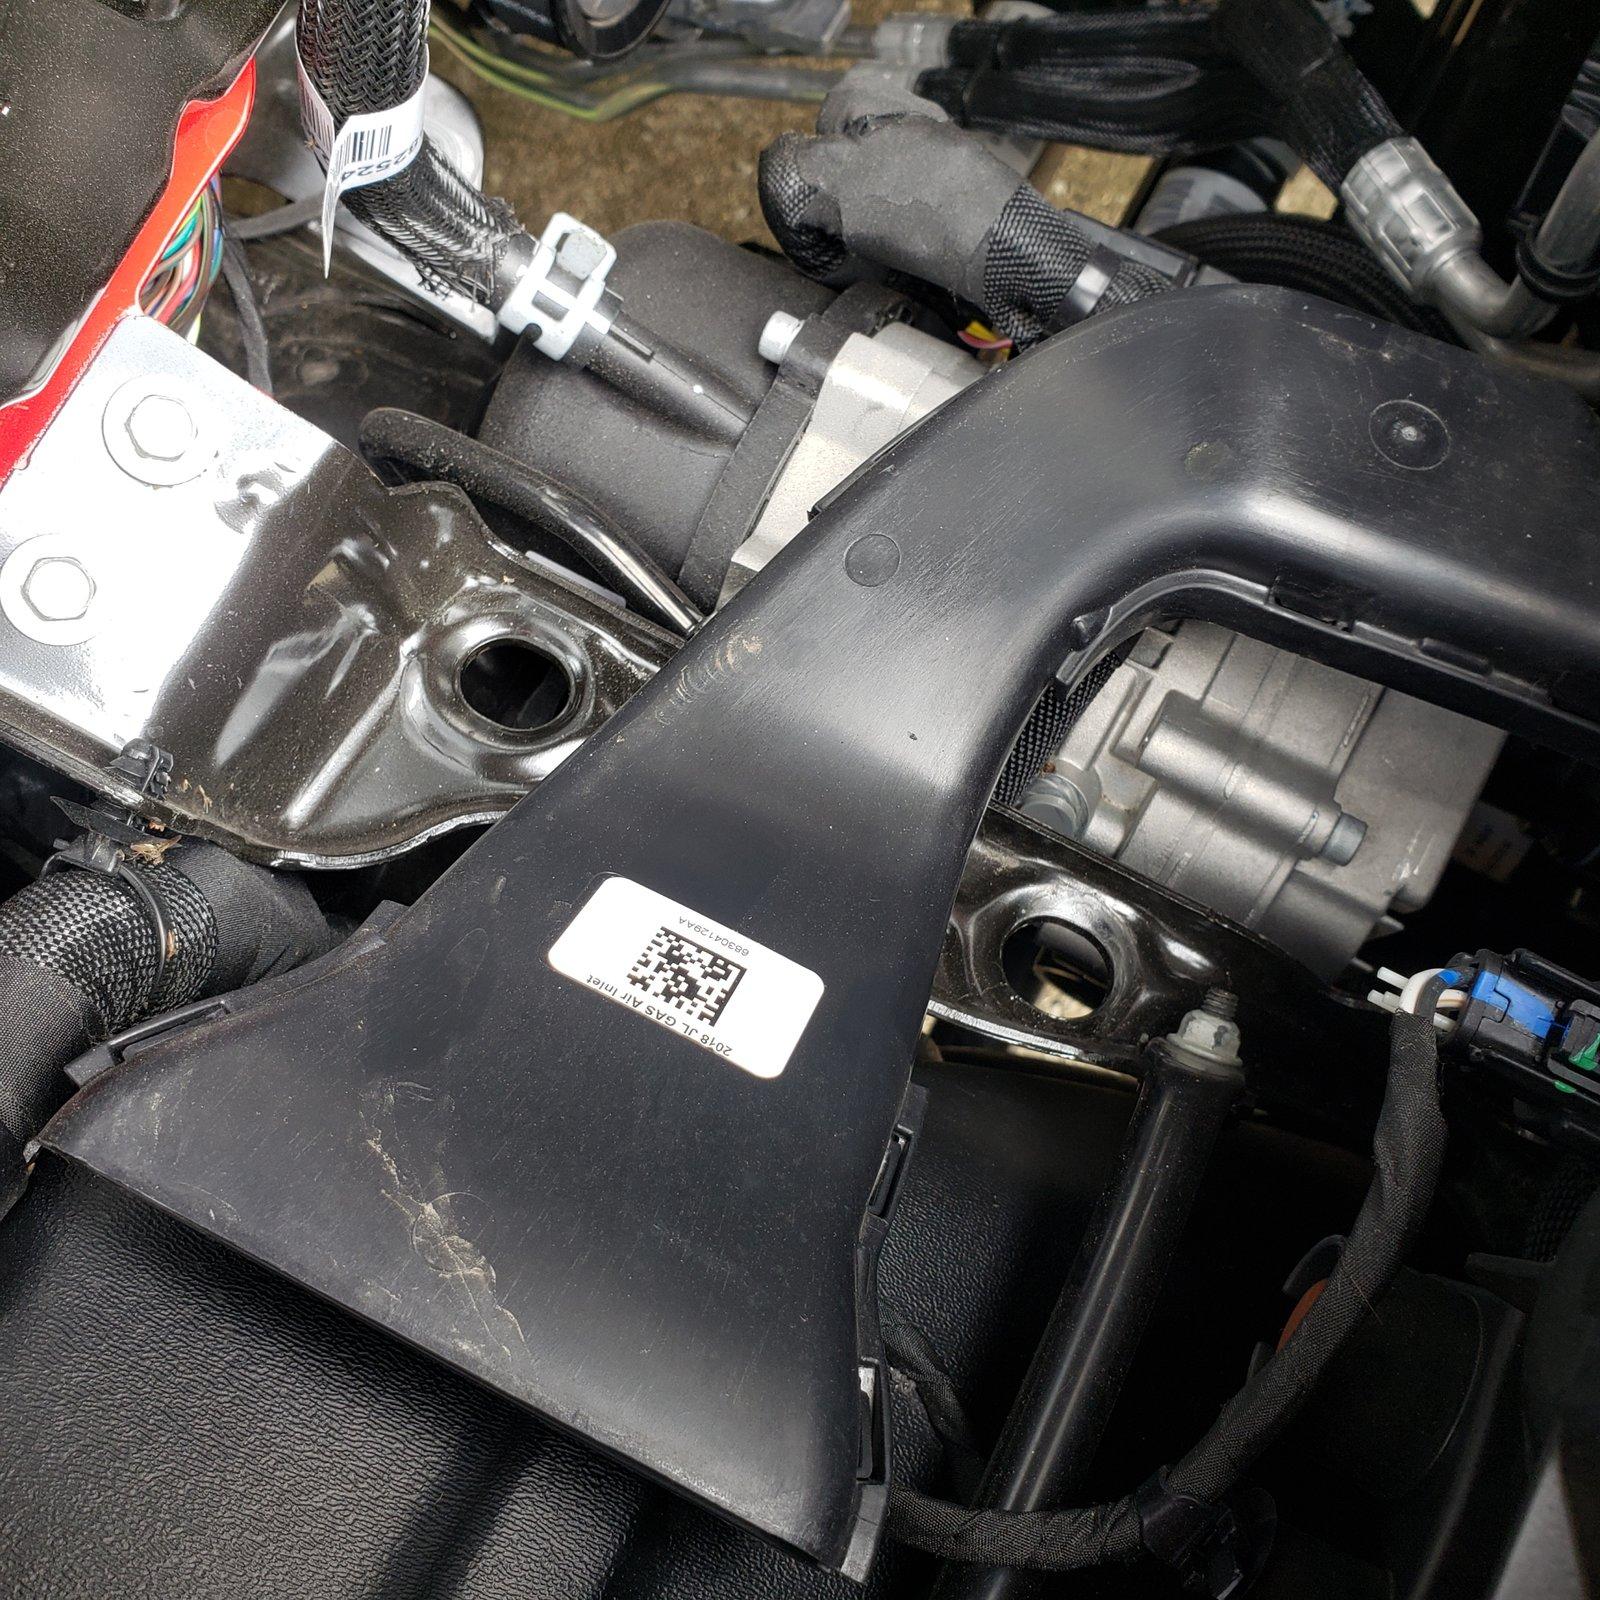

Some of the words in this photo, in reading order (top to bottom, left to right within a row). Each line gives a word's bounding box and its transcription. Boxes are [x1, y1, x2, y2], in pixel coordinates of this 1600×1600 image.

[679, 916, 749, 957] 68304129AA
[586, 974, 619, 997] Inlet
[620, 992, 643, 1008] Air
[645, 1004, 677, 1027] GAS
[682, 1022, 698, 1037] JL
[700, 1034, 733, 1057] 2018
